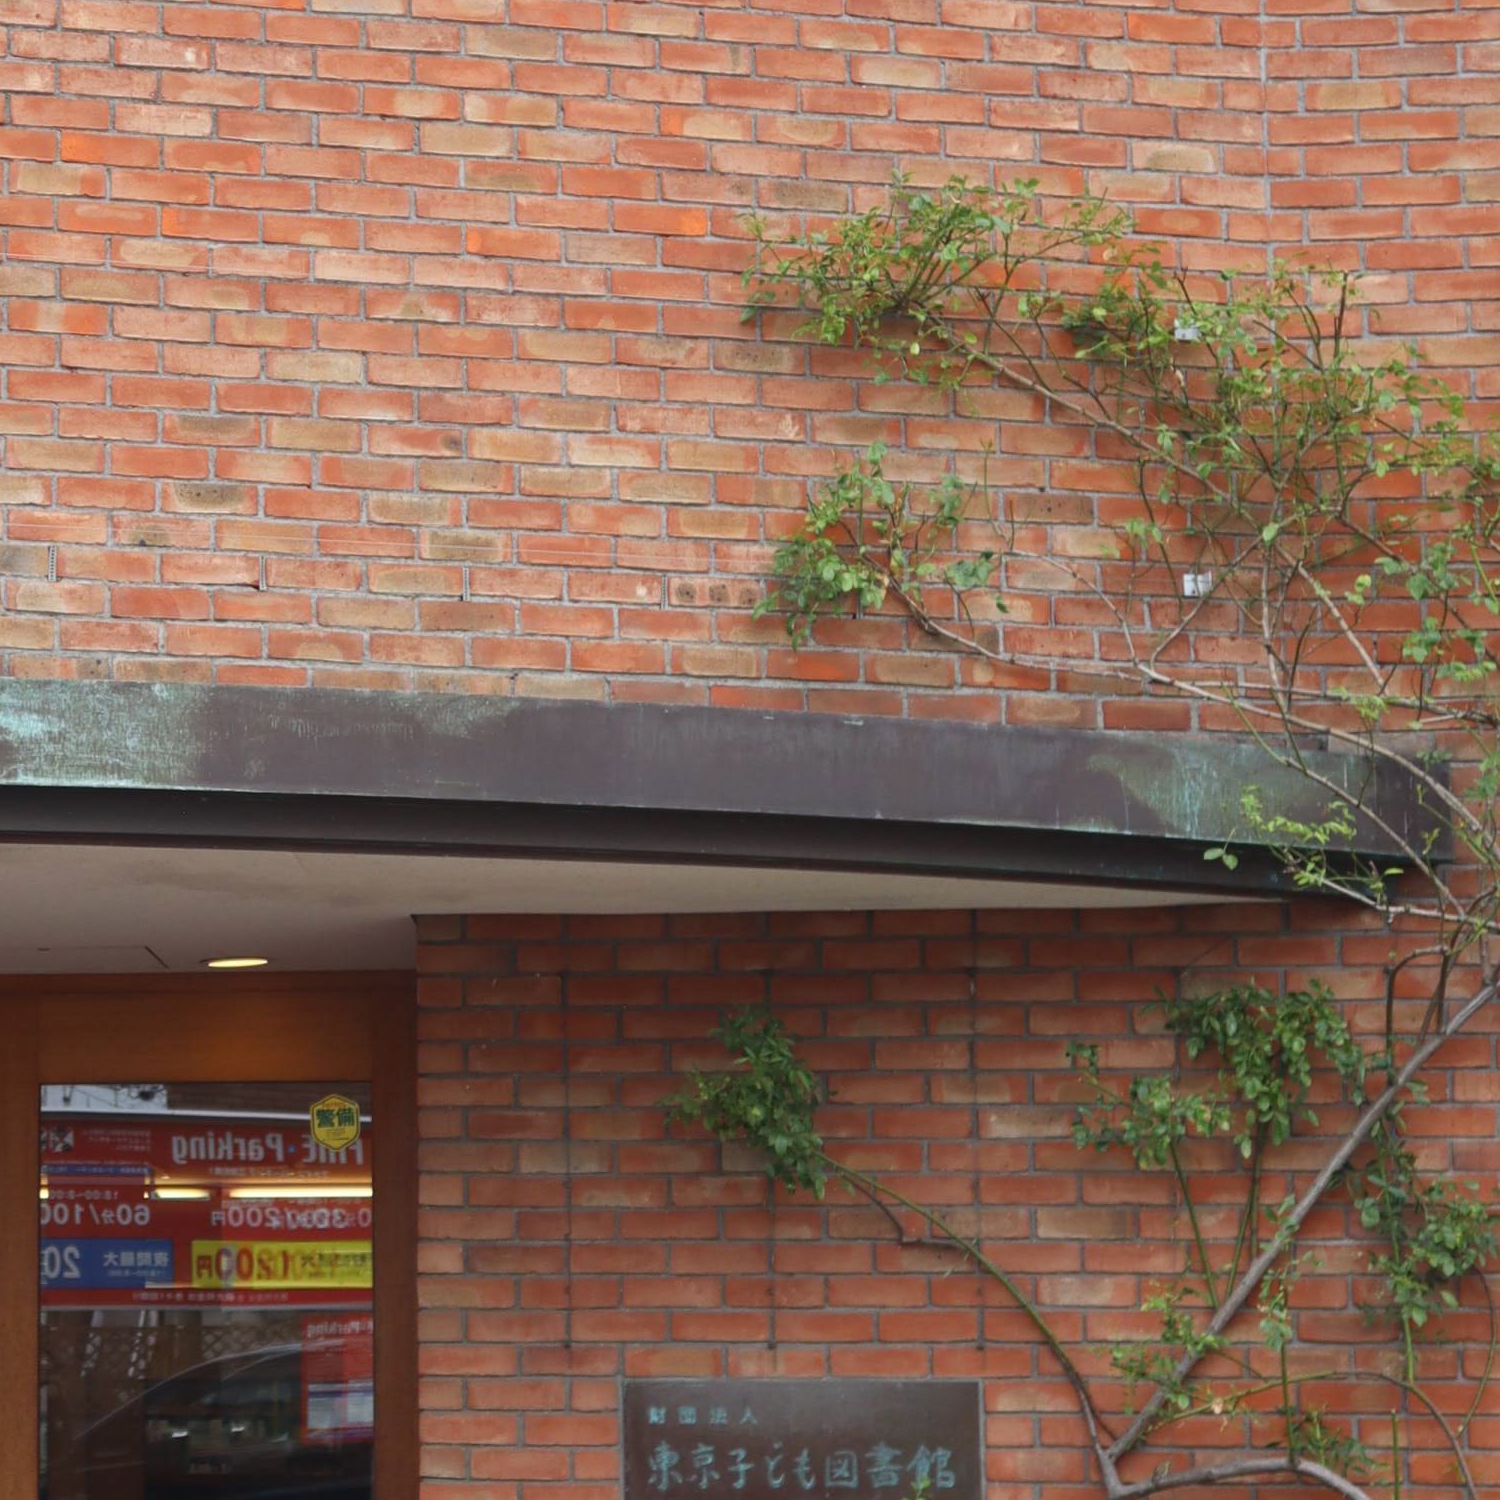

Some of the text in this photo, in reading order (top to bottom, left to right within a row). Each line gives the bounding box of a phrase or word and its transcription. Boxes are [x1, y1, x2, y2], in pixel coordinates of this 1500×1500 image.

[315, 1107, 355, 1128] 警備
[647, 1405, 758, 1426] 財団法人
[646, 1439, 957, 1492] 東京子ども図書館
